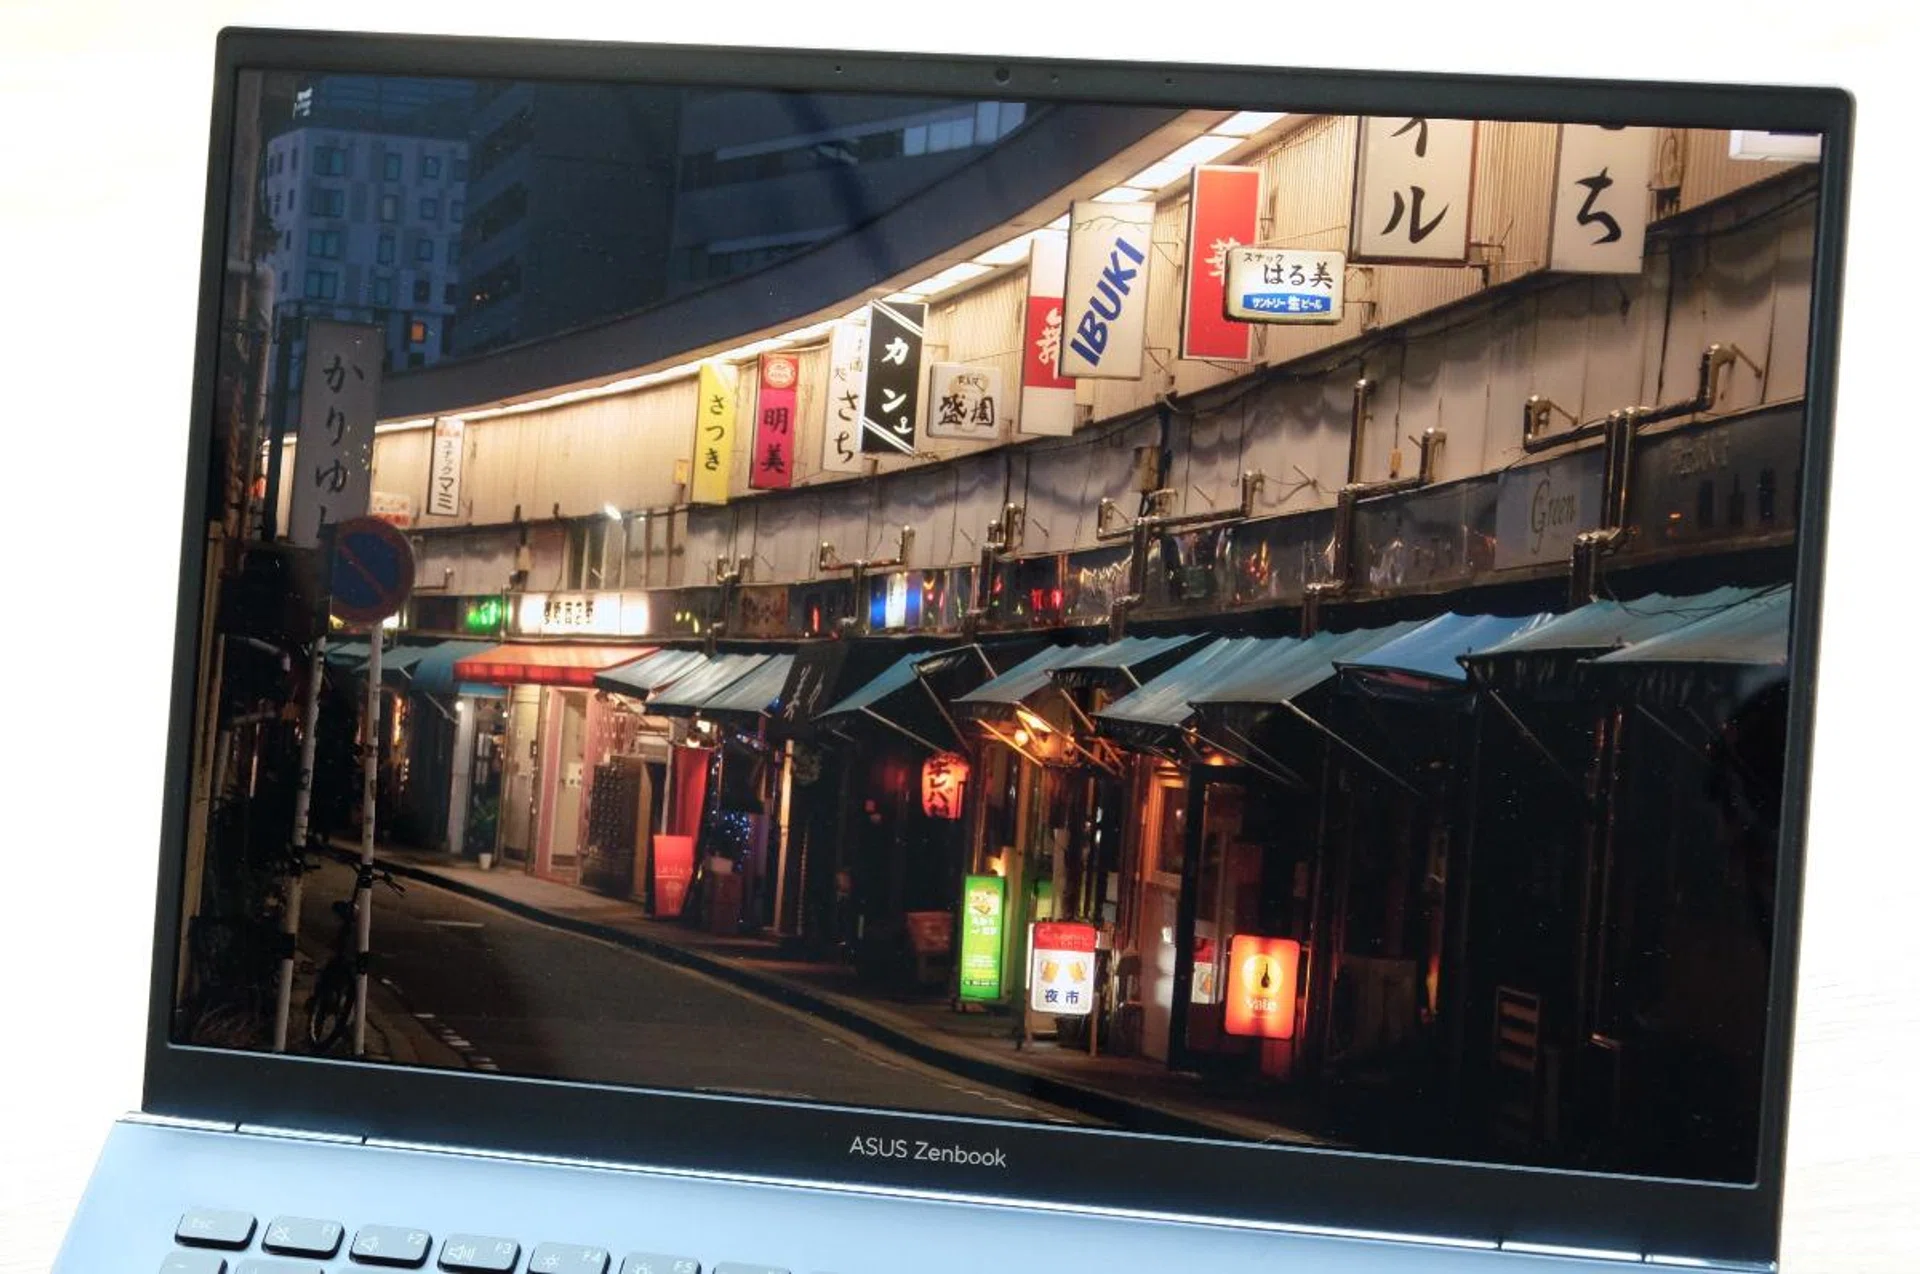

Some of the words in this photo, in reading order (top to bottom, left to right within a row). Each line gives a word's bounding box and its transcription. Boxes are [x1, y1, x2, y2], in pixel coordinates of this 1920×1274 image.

[1575, 125, 1622, 246] ち
[1263, 261, 1333, 290] はる美
[1070, 237, 1145, 367] IBUKI
[705, 395, 725, 471] さつき
[760, 407, 788, 474] 明美
[1044, 989, 1080, 1005] 夜市
[849, 1136, 907, 1158] ASUS
[914, 1140, 1007, 1168] Zenbook
[407, 1232, 425, 1245] F2
[495, 1242, 511, 1255] F3
[583, 1251, 601, 1264] F4
[673, 1260, 693, 1273] F5
